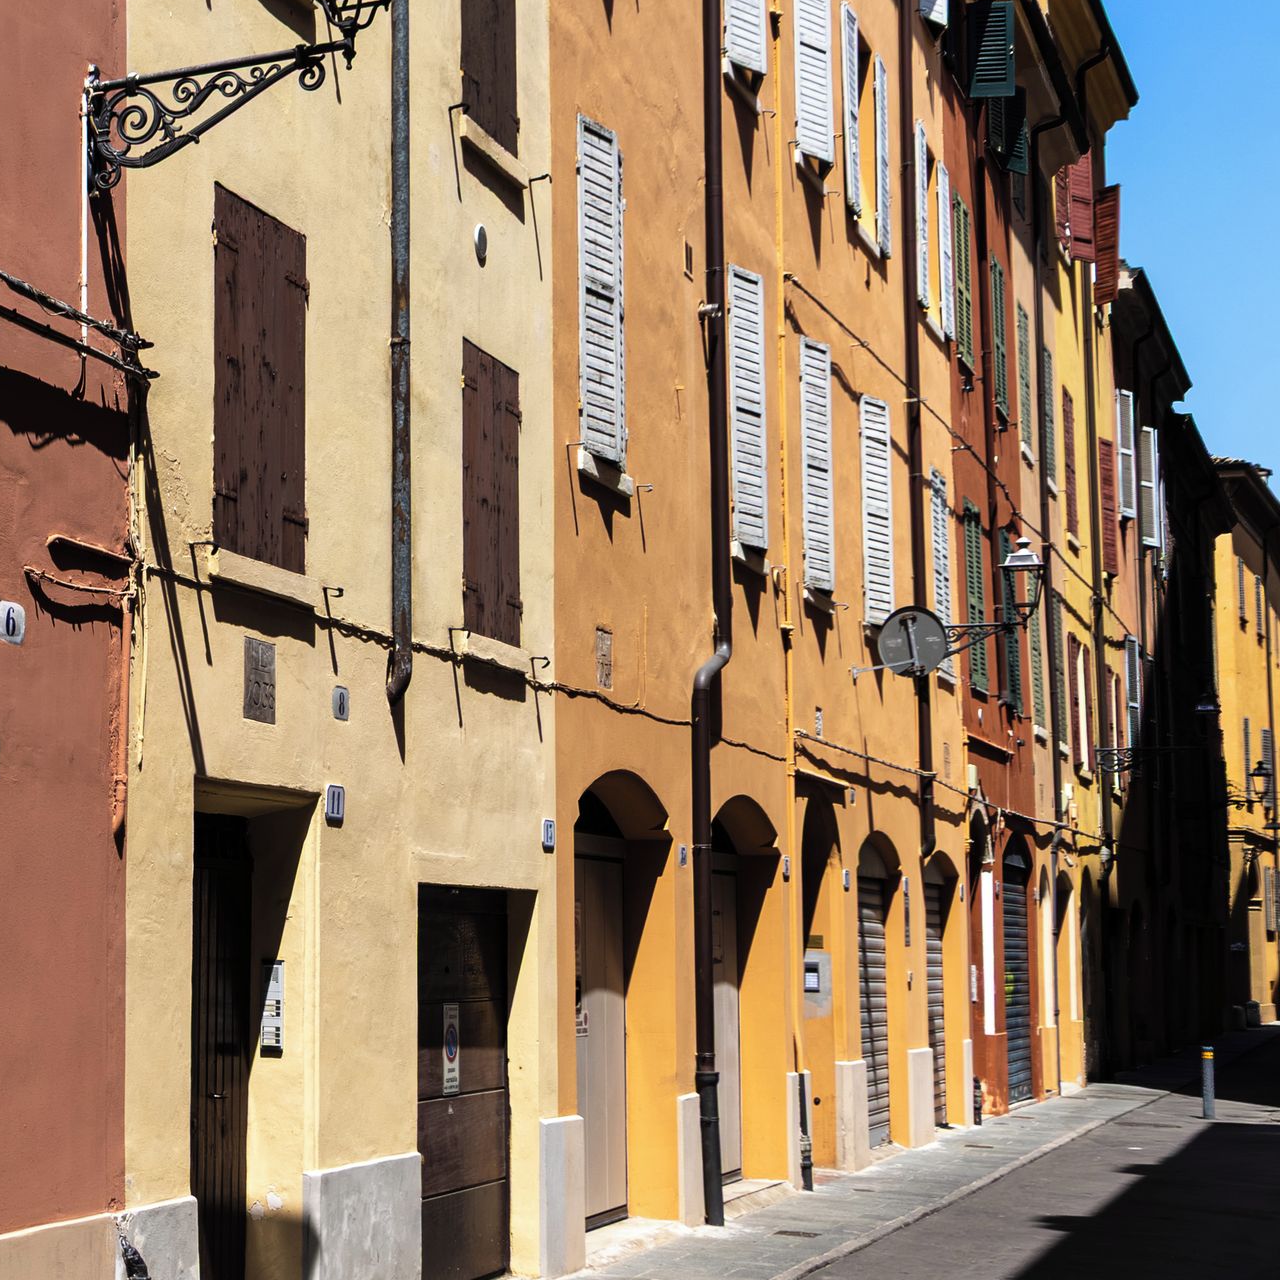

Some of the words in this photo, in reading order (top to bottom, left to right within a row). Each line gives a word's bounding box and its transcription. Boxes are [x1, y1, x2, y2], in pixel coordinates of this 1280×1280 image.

[5, 606, 16, 637] 6
[338, 691, 346, 716] 8
[331, 790, 341, 816] 11
